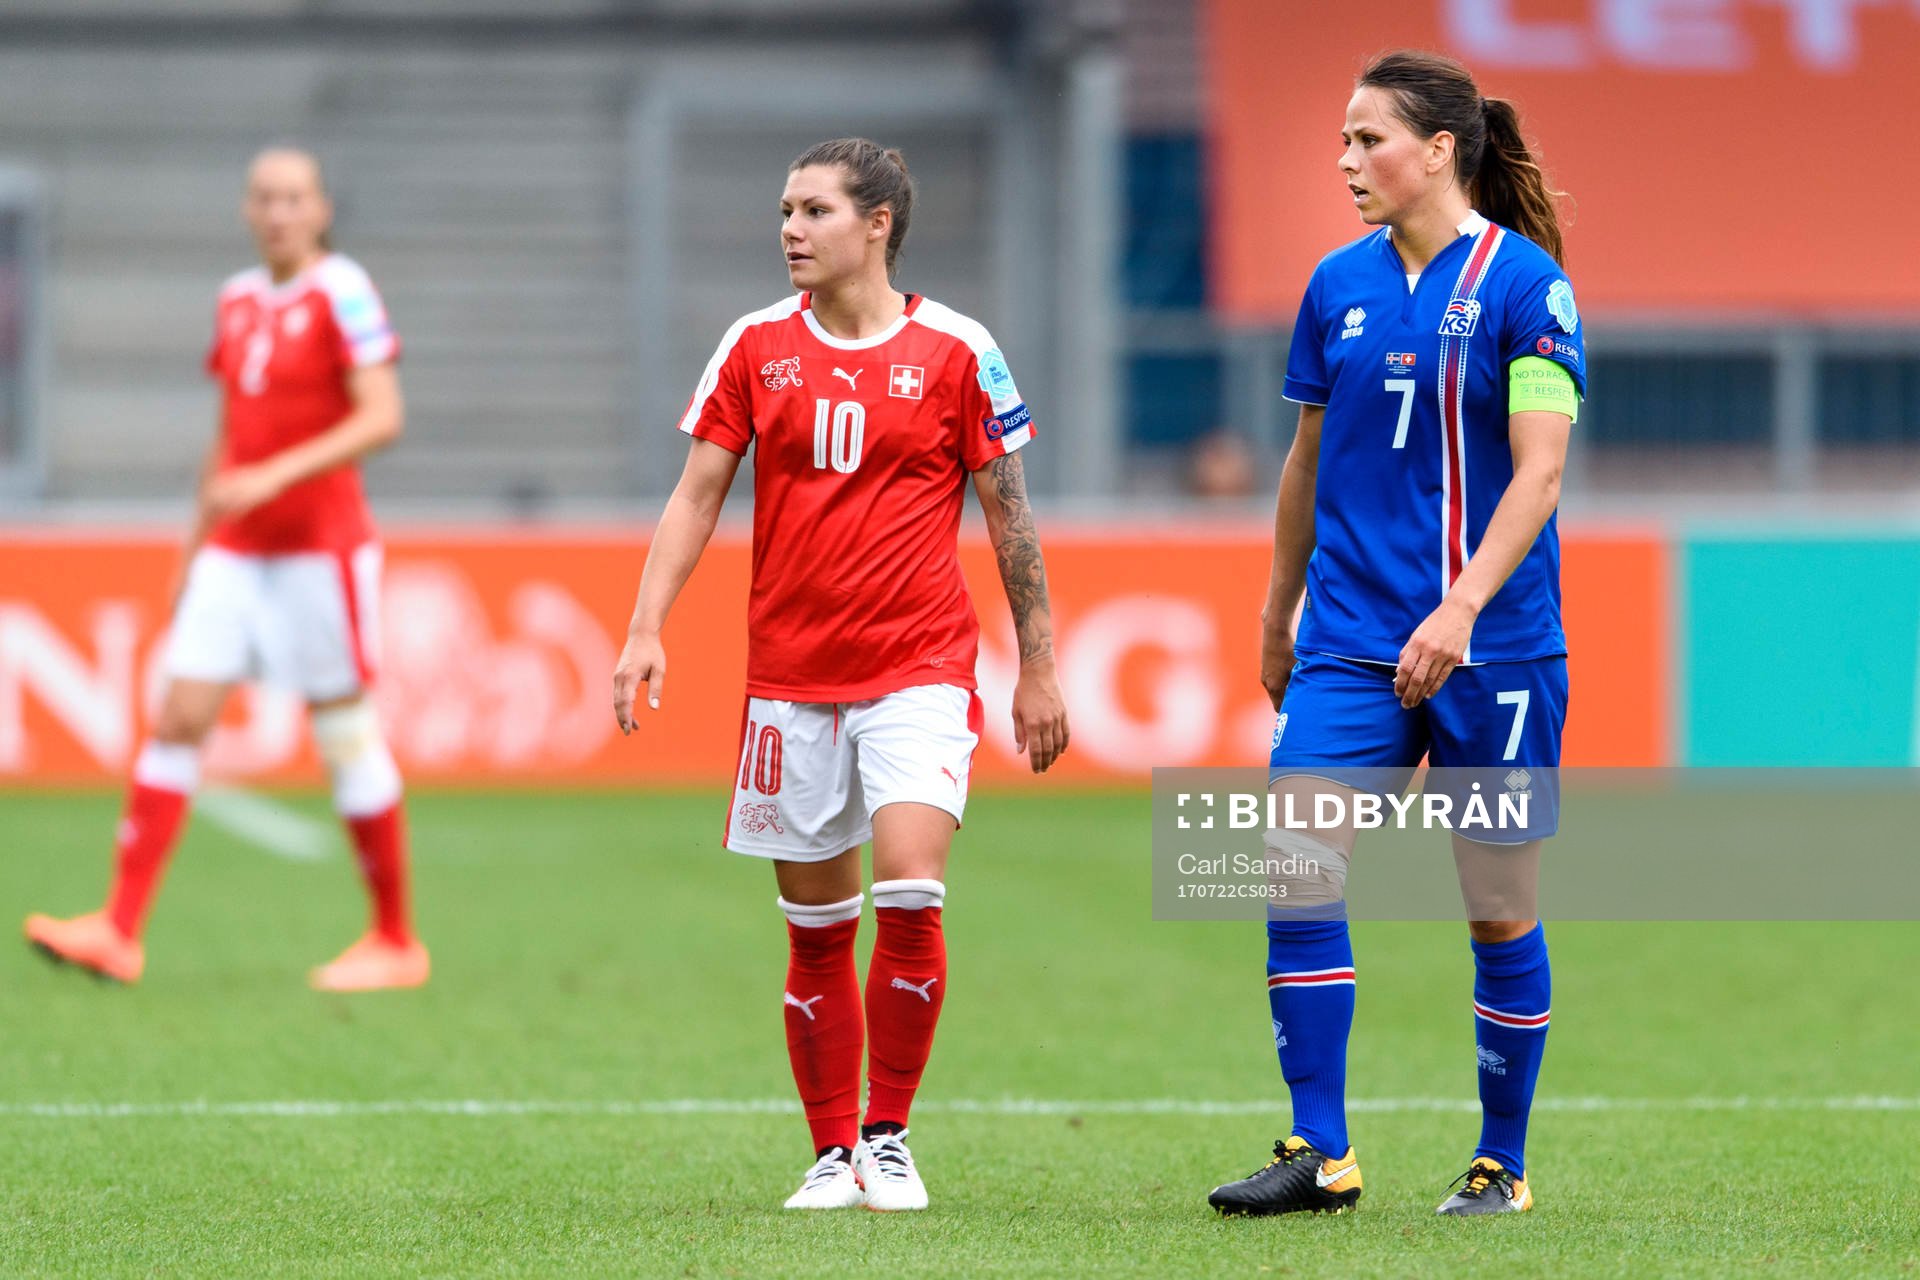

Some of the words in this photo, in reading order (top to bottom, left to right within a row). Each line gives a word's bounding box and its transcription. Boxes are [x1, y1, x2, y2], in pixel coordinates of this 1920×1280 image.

[1515, 370, 1529, 379] NO
[1531, 369, 1545, 378] TO
[813, 398, 866, 474] 10
[1384, 379, 1415, 449] 7
[740, 720, 783, 796] 10
[1496, 689, 1530, 760] 7
